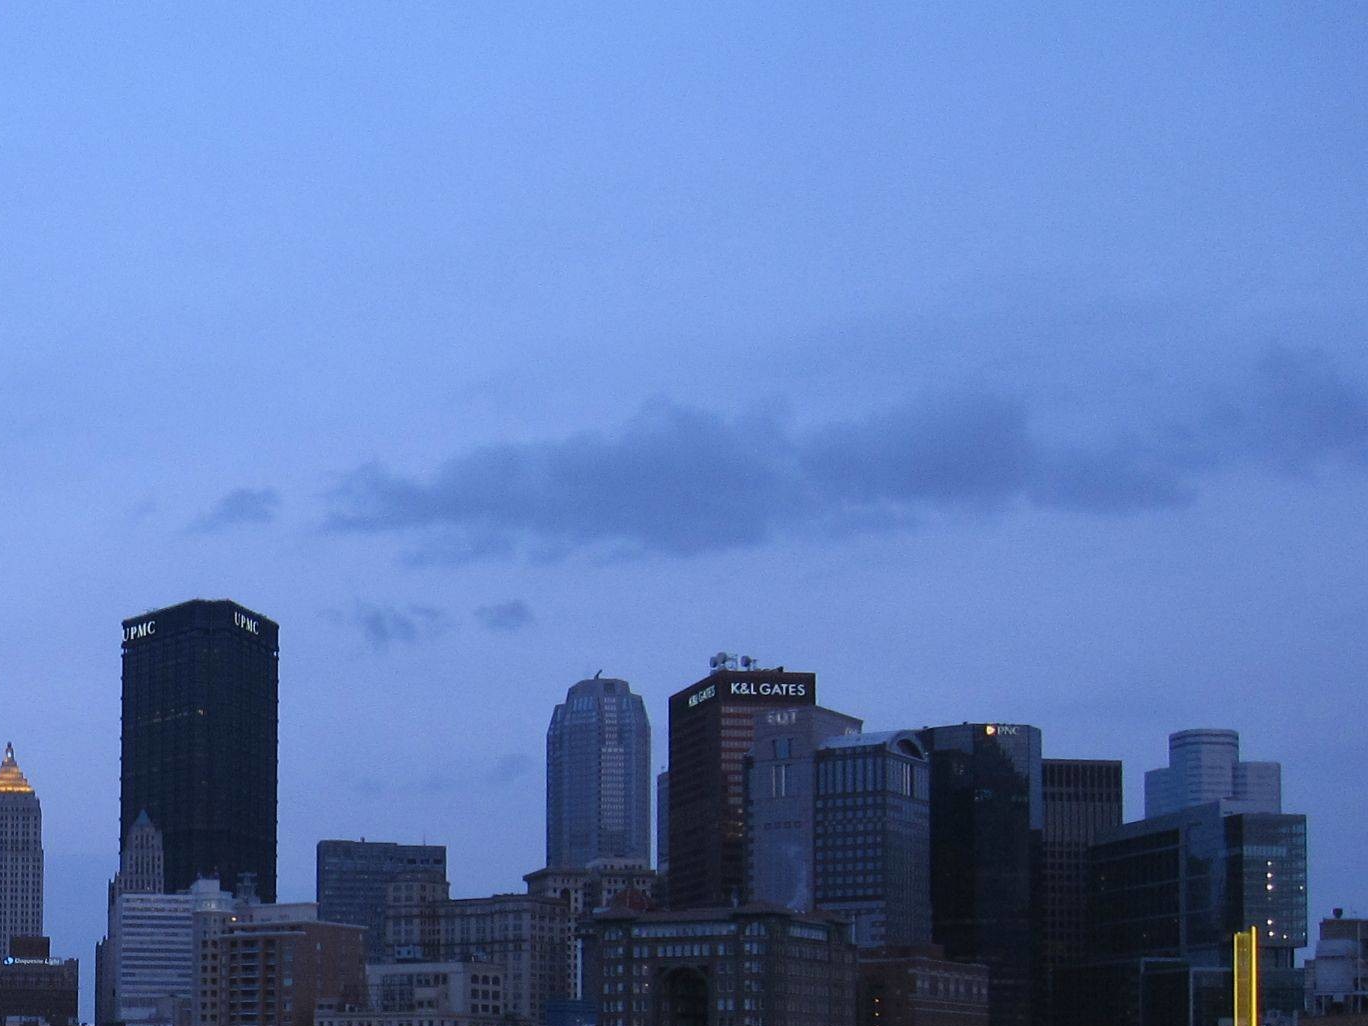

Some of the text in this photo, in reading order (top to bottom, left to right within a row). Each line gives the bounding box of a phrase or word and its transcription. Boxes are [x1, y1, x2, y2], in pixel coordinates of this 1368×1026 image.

[123, 621, 156, 641] UPMC
[234, 611, 259, 635] UPMC
[731, 682, 806, 696] K&L GATES
